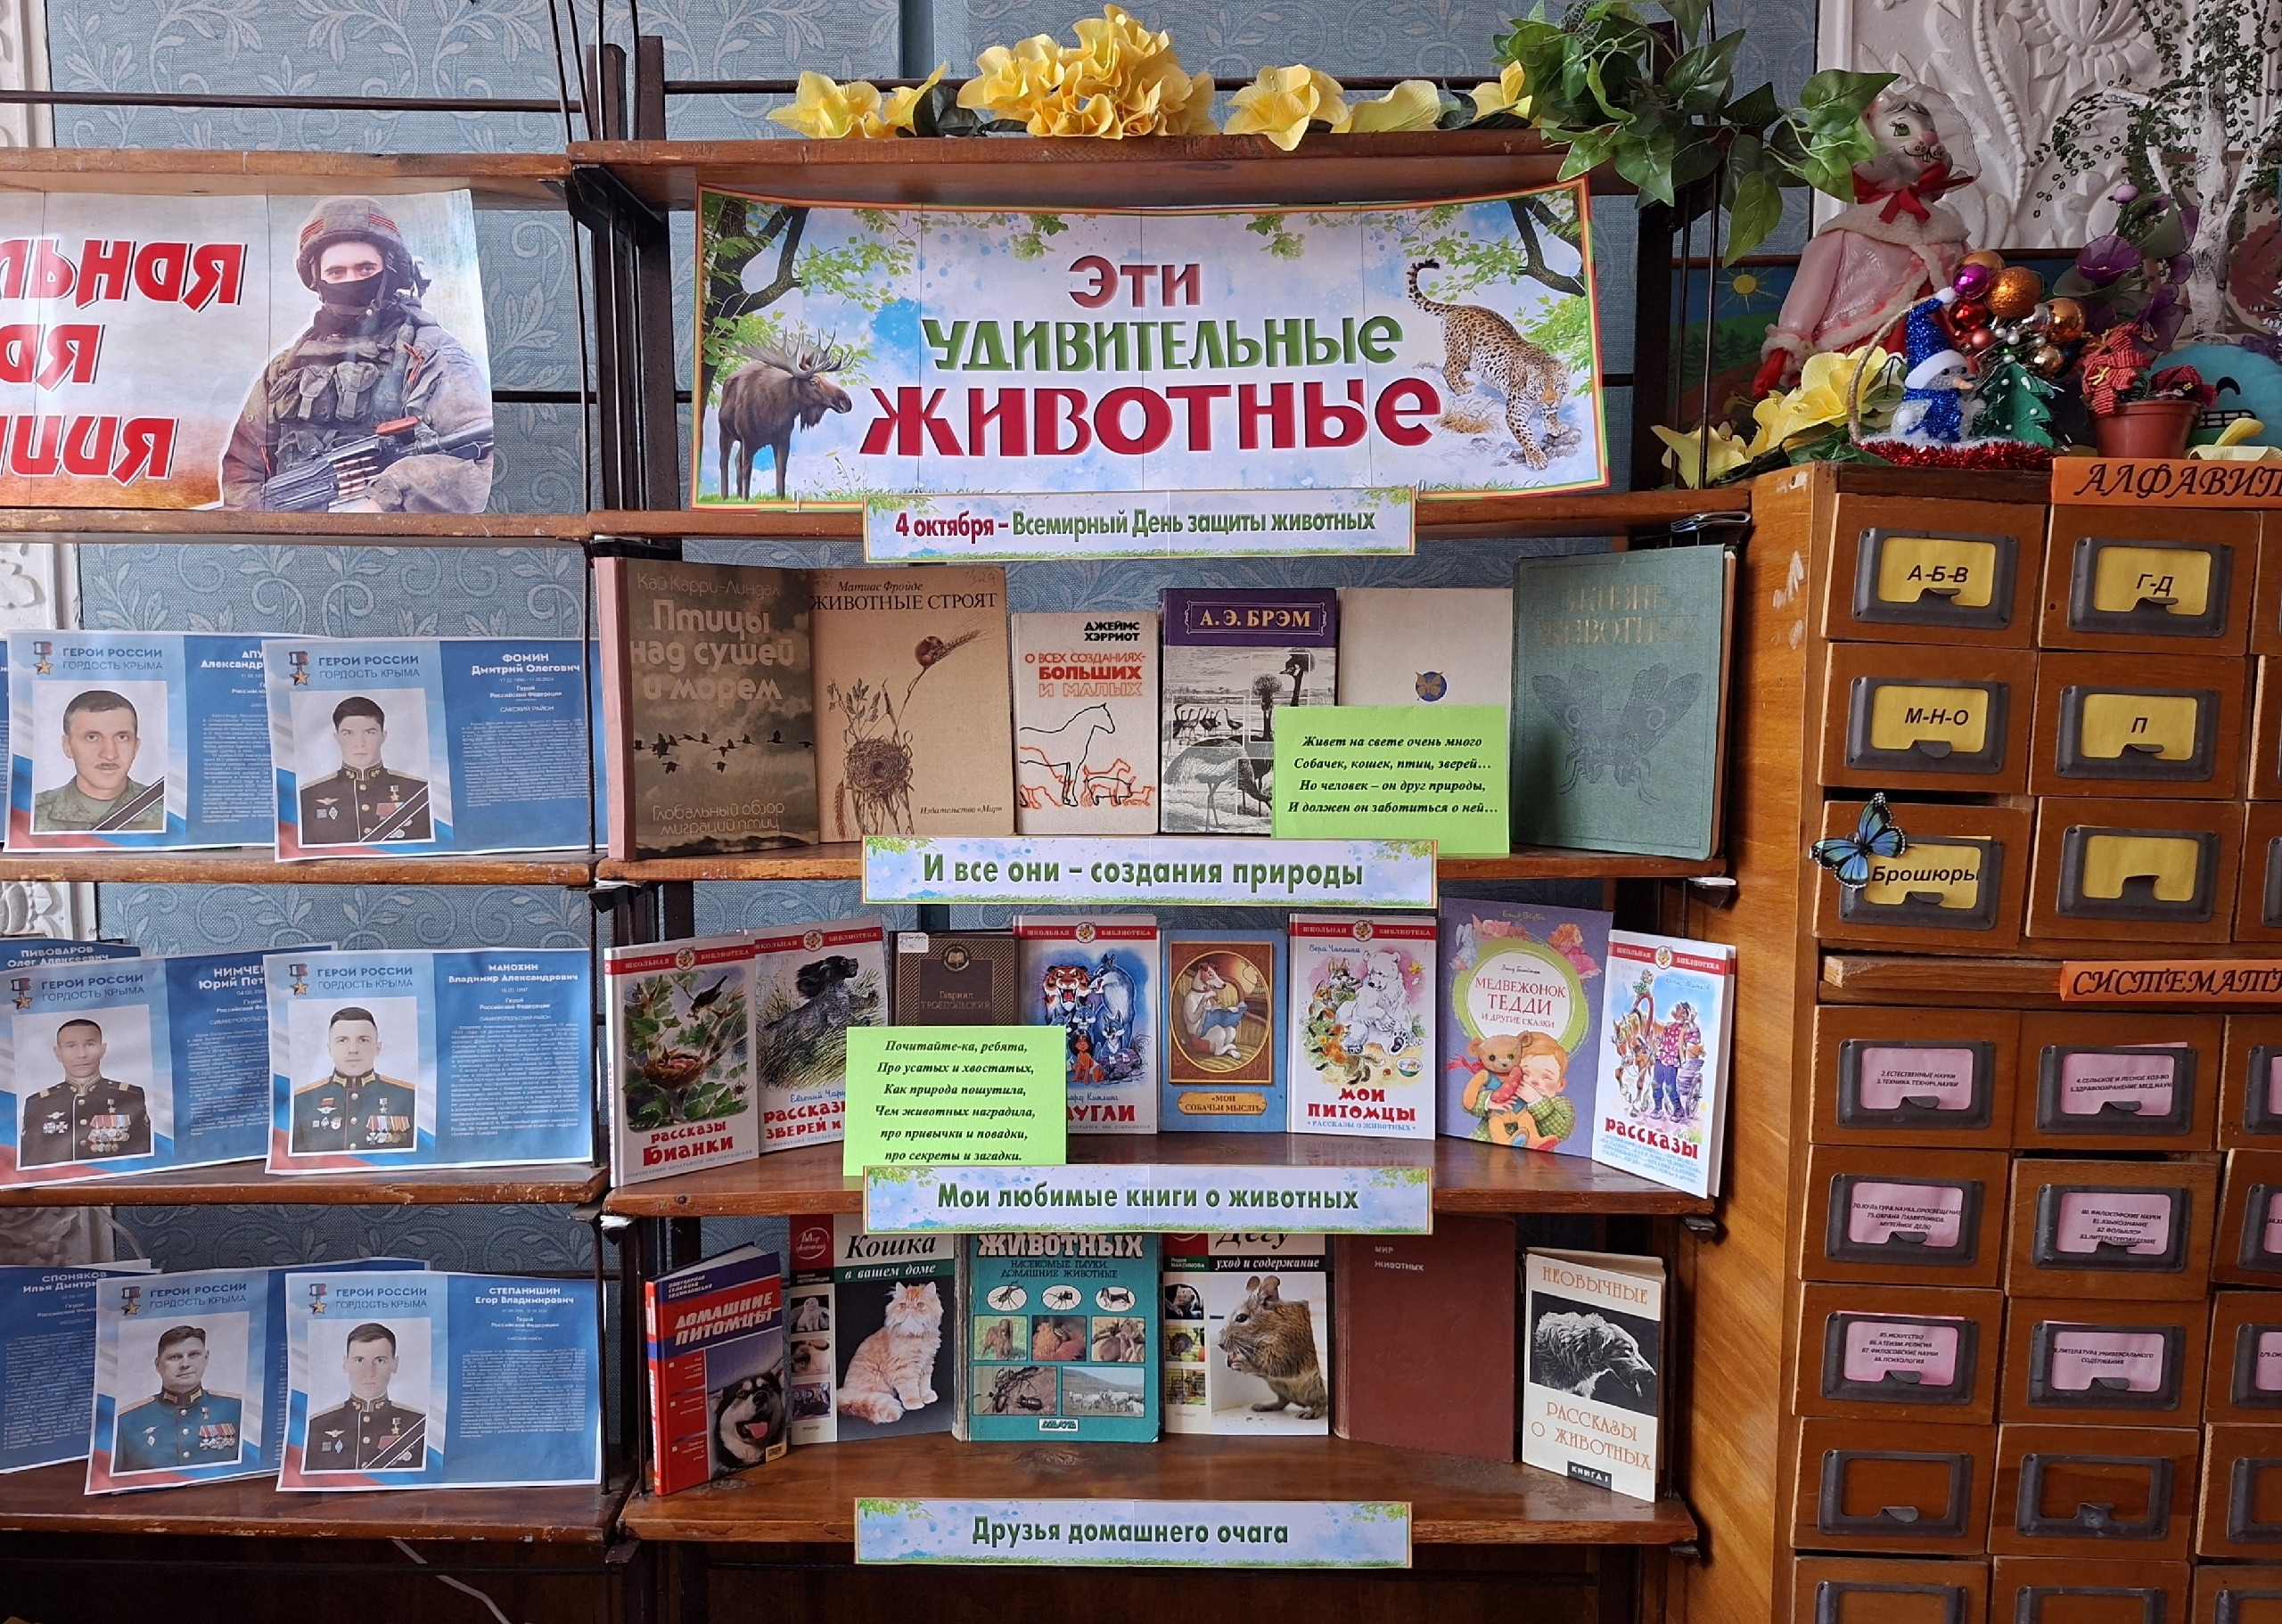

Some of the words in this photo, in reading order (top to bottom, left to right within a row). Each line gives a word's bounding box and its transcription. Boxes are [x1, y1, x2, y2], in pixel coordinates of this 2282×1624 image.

[896, 513, 909, 536] 4
[914, 511, 994, 544] октября
[1013, 510, 1128, 542] Всемирный
[1132, 509, 1183, 537] День
[1188, 513, 1266, 535] защиты
[1271, 513, 1376, 531] животных
[1907, 566, 1969, 584] А-Б-В
[838, 581, 882, 592] Матиас
[883, 581, 923, 594] Фройде
[2137, 573, 2175, 596] Г-Д
[809, 595, 923, 610] ЖИВОТНЫЕ
[928, 594, 997, 609] СТРОЯТ
[653, 599, 769, 641] Птицы
[1248, 611, 1310, 627] БРЭМ
[1084, 621, 1140, 631] ДЖЕЙМС
[1084, 633, 1140, 641] ХЭРРИОТ
[62, 648, 103, 658] ГЕРОИ
[109, 649, 161, 658] РОССИИ
[502, 652, 549, 663] ФОМИН
[630, 640, 685, 673] над
[694, 639, 794, 672] сушей
[1039, 653, 1066, 663] ВСЕХ
[62, 660, 119, 670] ГОРДОСТЬ
[123, 661, 162, 670] КРЫМА
[318, 657, 361, 666] ГЕРОИ
[365, 656, 419, 665] РОССИИ
[319, 669, 377, 680] ГОРДОСТЬ
[382, 668, 420, 678] КРЫМА
[472, 664, 522, 676] Дмитрий
[526, 663, 579, 674] Олегович
[1039, 666, 1142, 679] БОЛЬШИХ
[643, 678, 661, 700] и
[670, 677, 783, 707] морем
[1039, 684, 1054, 697] И
[1063, 683, 1142, 697] МАЛЫХ
[1905, 708, 1970, 726] М-Н-О
[1302, 736, 1346, 746] Живет
[1445, 739, 1482, 747] много
[1294, 759, 1347, 769] Собачек,
[1351, 760, 1393, 769] кошек,
[1397, 760, 1434, 770] птиц,
[1300, 780, 1317, 791] Но
[1321, 782, 1367, 791] человек
[1400, 781, 1425, 792] друг
[1429, 781, 1485, 792] природы,
[653, 803, 739, 821] Глобальный
[743, 800, 784, 816] обзор
[1302, 803, 1350, 812] должен
[1372, 802, 1447, 812] заботиться
[923, 854, 943, 881] И
[955, 862, 998, 882] все
[1008, 862, 1059, 882] они
[1090, 862, 1222, 886] создания
[1233, 864, 1362, 893] природы
[828, 931, 878, 942] БИБЛИОТЕКА
[21, 946, 94, 957] ПИВОВАРОВ
[625, 959, 669, 969] ШКОЛЬНАЯ
[701, 949, 750, 960] БИБЛИОТЕКА
[317, 968, 357, 977] ГЕРОИ
[361, 967, 413, 976] РОССИИ
[488, 964, 538, 972] МАНОХИН
[198, 978, 237, 989] Юрий
[318, 980, 373, 990] ГОРДОСТЬ
[375, 980, 413, 988] КРЫМА
[448, 975, 498, 984] Владимир
[502, 974, 578, 982] Александрович
[1475, 977, 1565, 998] МЕДВЕЖОНОК
[1488, 994, 1551, 1015] ТЕДДИ
[1490, 1015, 1520, 1023] ДРУГИЕ
[885, 1041, 977, 1053] Почитайте-ка,
[981, 1042, 1028, 1054] ребята,
[877, 1062, 901, 1075] Про
[904, 1065, 948, 1074] усатых
[962, 1065, 1034, 1075] хвостатых,
[884, 1084, 907, 1094] Как
[910, 1084, 957, 1096] природа
[962, 1087, 1026, 1096] пошутила,
[1339, 1088, 1385, 1103] МОИ
[876, 1105, 899, 1116] Чем
[973, 1107, 1035, 1119] наградила,
[1308, 1103, 1416, 1122] ПИТОМЦЫ
[881, 1131, 901, 1140] про
[905, 1130, 963, 1140] привычки
[977, 1128, 1028, 1140] повадки,
[643, 1136, 734, 1167] Бианки
[885, 1152, 906, 1162] про
[909, 1152, 960, 1162] секреты
[974, 1151, 1022, 1162] загадки.
[938, 1183, 989, 1208] Мои
[998, 1181, 1117, 1207] любимые
[1127, 1188, 1197, 1207] книги
[1228, 1190, 1359, 1210] животных
[845, 1234, 936, 1259] Кошка
[977, 1234, 1143, 1258] ЖИВОТНЫХ
[1215, 1258, 1240, 1270] уход
[1252, 1259, 1319, 1270] содержание
[1375, 1260, 1424, 1271] ЖИВОТНЫХ
[41, 1271, 107, 1283] СПОНЯКОВ
[858, 1267, 899, 1278] вашем
[906, 1264, 936, 1275] доме
[23, 1284, 52, 1293] Илья
[336, 1289, 374, 1297] ГЕРОИ
[378, 1288, 427, 1296] РОССИИ
[489, 1287, 561, 1295] СТЕПАНИШИН
[336, 1300, 389, 1310] ГОРДОСТЬ
[391, 1300, 428, 1308] КРЫМА
[475, 1297, 498, 1305] Егор
[501, 1296, 574, 1305] Владимирович
[675, 1292, 773, 1329] ДОМАШНИЕ
[675, 1308, 774, 1346] ПИТОМЦЫ
[1547, 1402, 1637, 1441] РАССКАЗЫ
[1555, 1427, 1652, 1470] ЖИВОТНЫХ
[973, 1516, 1060, 1548] Друзья
[1069, 1523, 1209, 1545] домашнего
[1218, 1525, 1288, 1543] очага
